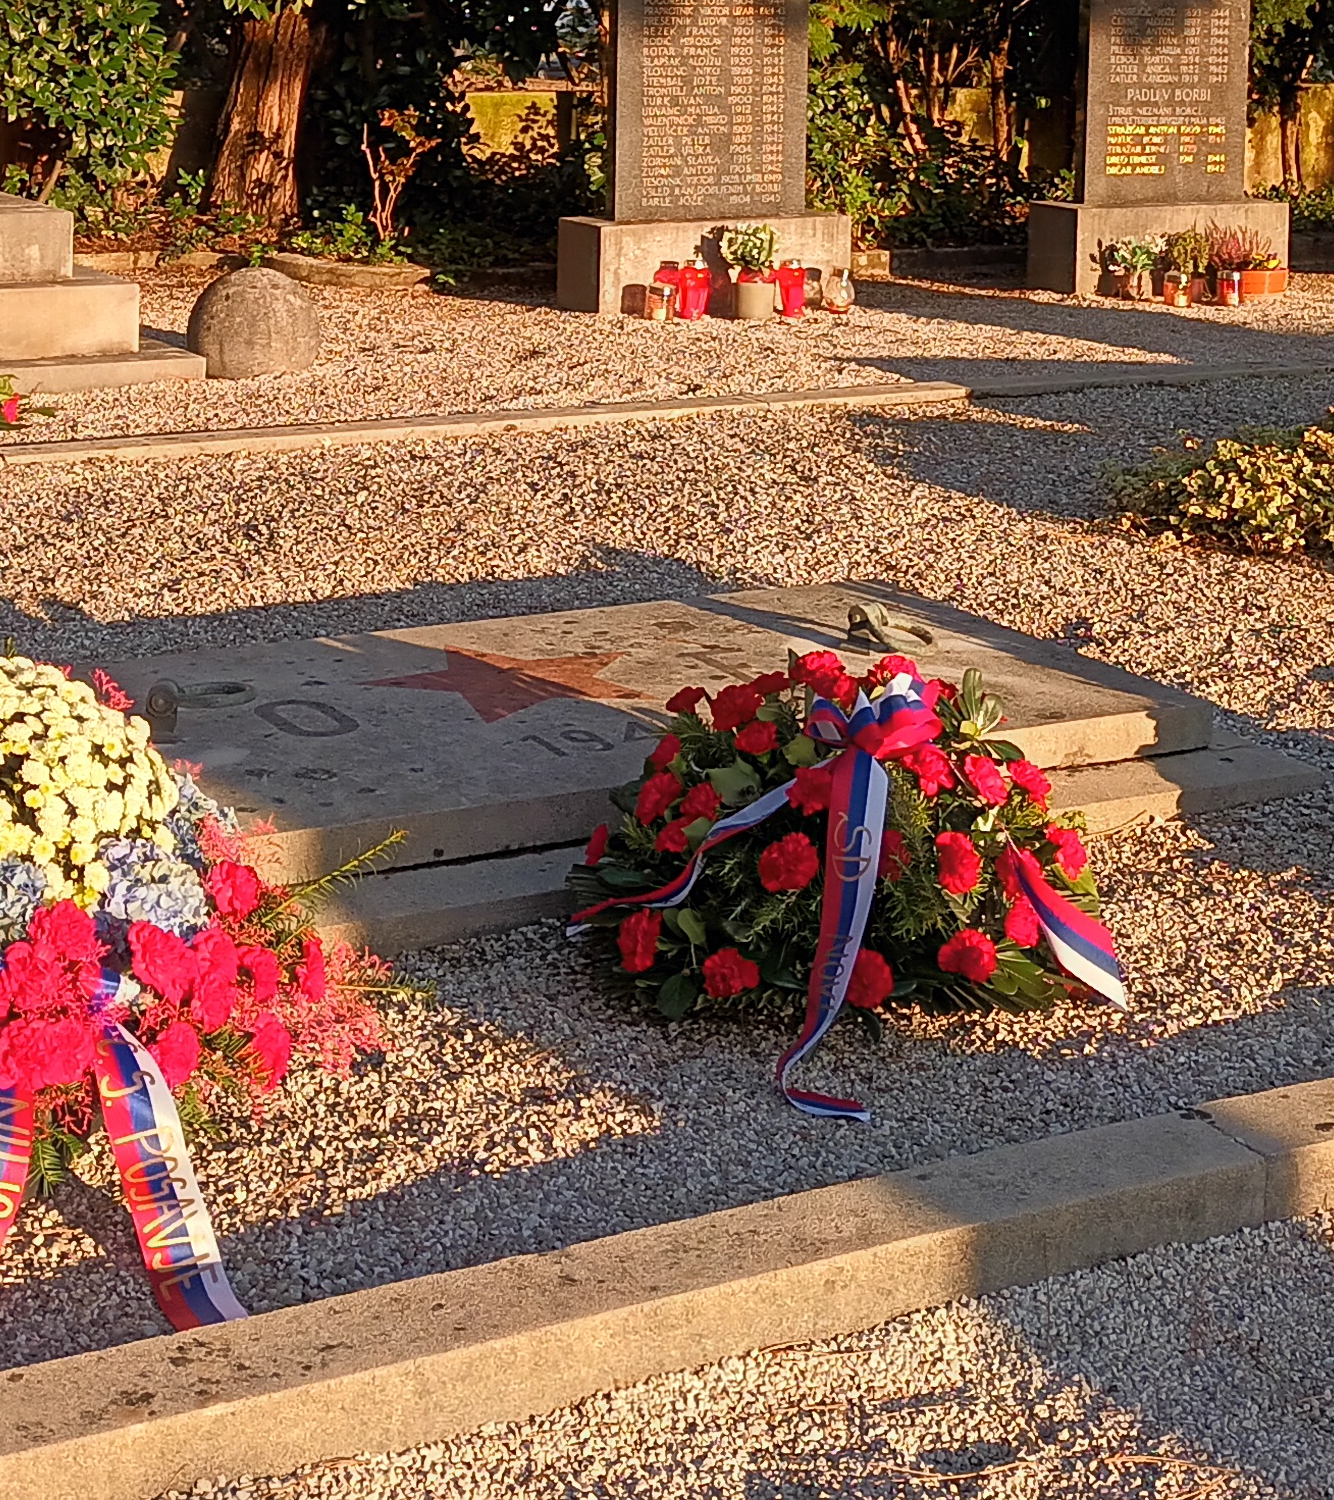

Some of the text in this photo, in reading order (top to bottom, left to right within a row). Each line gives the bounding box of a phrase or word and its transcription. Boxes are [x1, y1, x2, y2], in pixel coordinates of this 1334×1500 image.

[1127, 89, 1210, 101] PADLI V BORBI
[114, 1125, 221, 1300] POSAVJE
